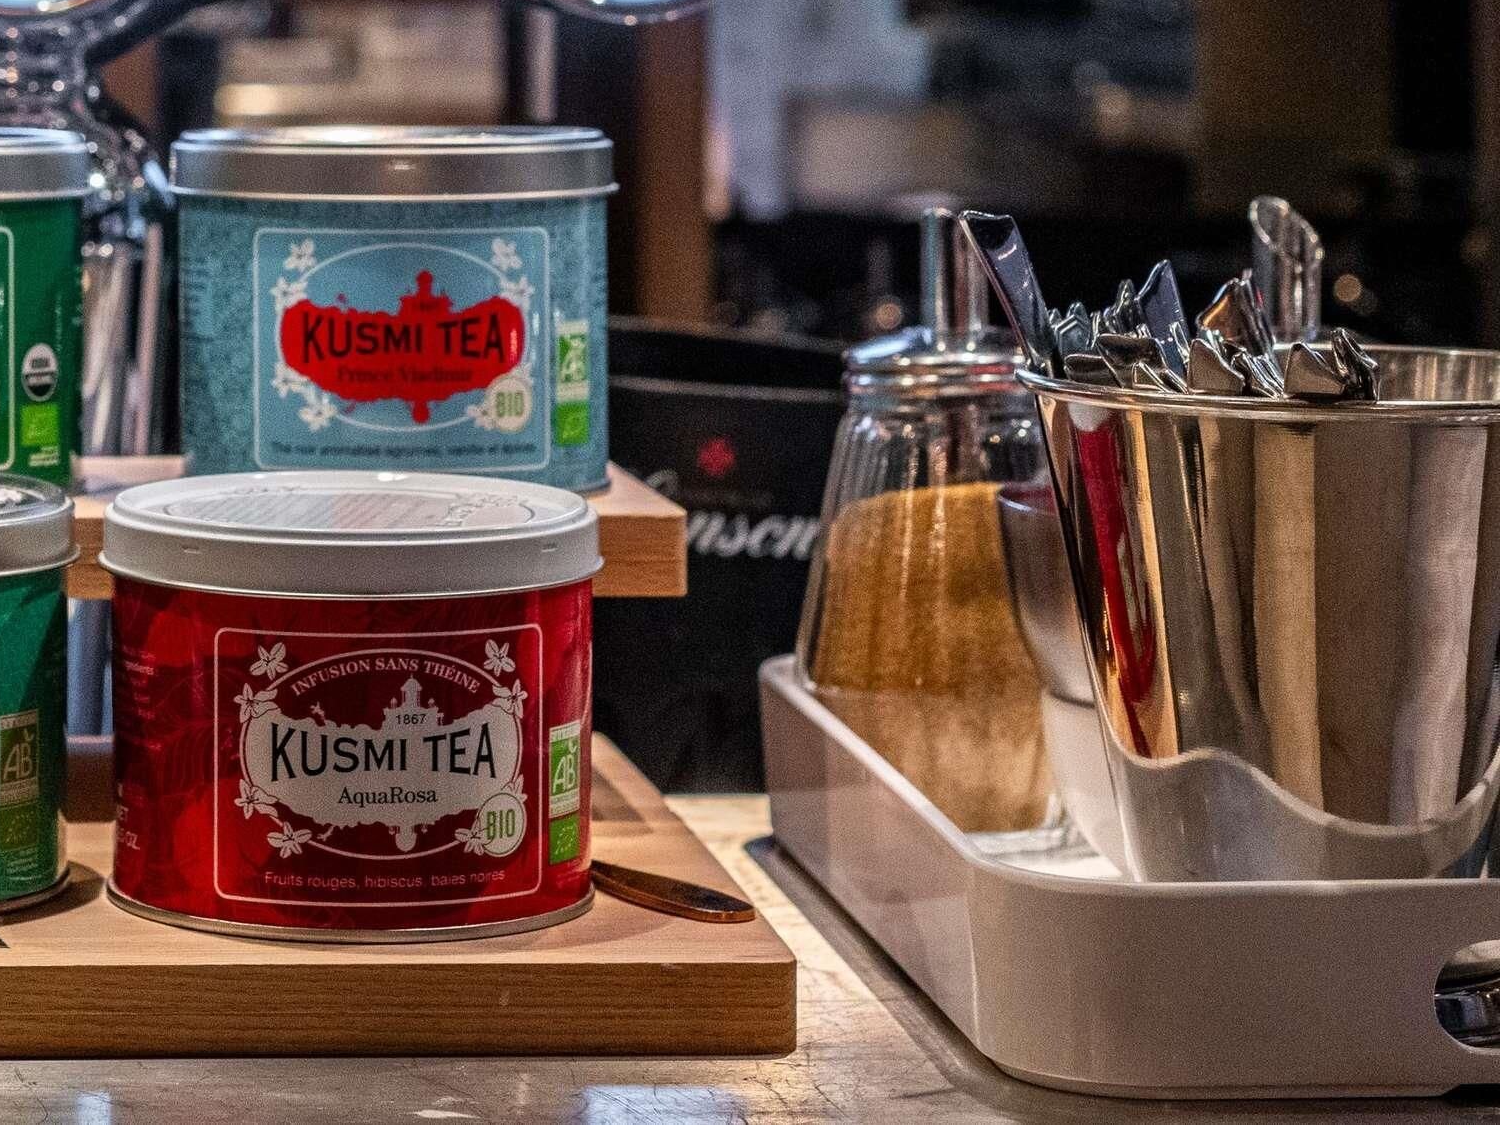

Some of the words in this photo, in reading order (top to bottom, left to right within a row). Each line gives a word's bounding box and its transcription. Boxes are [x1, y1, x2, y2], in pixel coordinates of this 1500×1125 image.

[302, 312, 422, 363] KUSMI
[437, 313, 505, 363] TEA
[495, 392, 523, 418] BIO
[290, 660, 370, 696] INFUSION
[374, 657, 419, 671] SANS
[423, 660, 480, 694] THÉINE
[395, 713, 428, 725] 1867
[4, 742, 32, 780] AB
[271, 722, 407, 782] KUSMI
[423, 723, 497, 779] TEA
[553, 754, 576, 793] AB
[338, 786, 437, 808] AquaRosa
[486, 808, 516, 840] BIO
[265, 871, 303, 887] Fruits
[307, 875, 360, 891] rouges,
[431, 873, 466, 886] baies
[470, 869, 505, 883] noires
